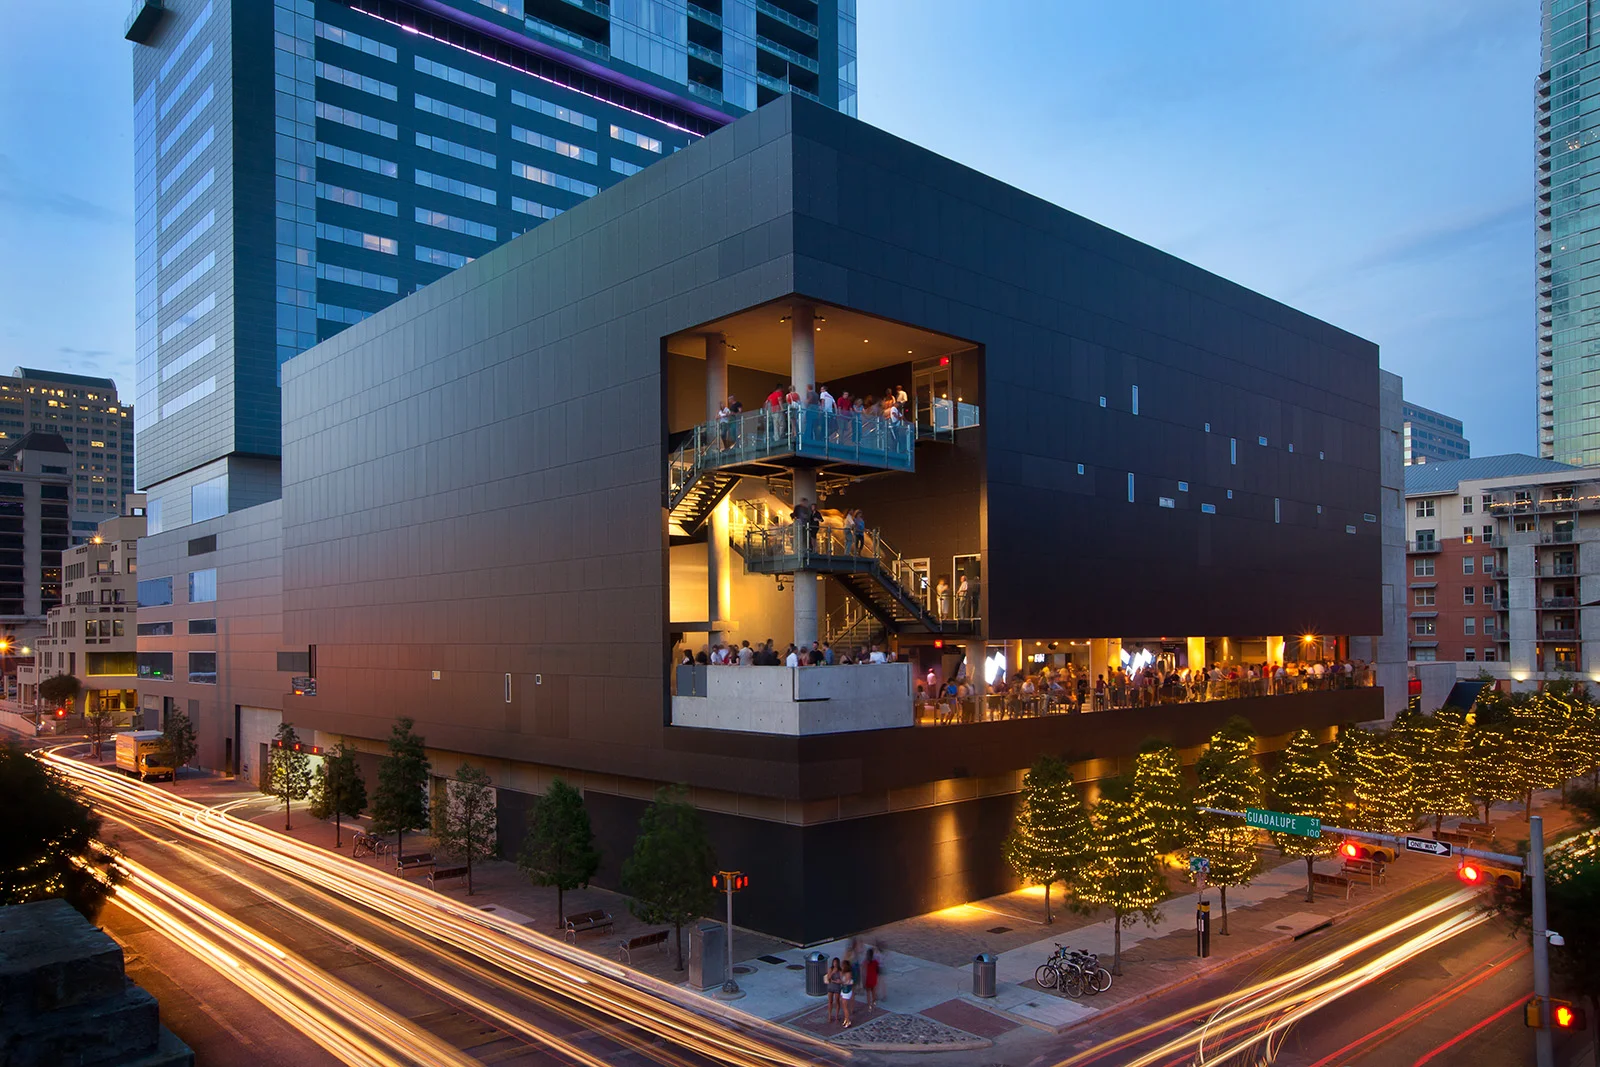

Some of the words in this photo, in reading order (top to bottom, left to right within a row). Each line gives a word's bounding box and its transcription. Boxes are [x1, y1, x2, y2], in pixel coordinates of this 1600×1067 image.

[1247, 812, 1296, 829] GUADALUPE
[1311, 818, 1320, 826] ST
[1307, 829, 1320, 838] 100
[1410, 841, 1422, 849] ONE
